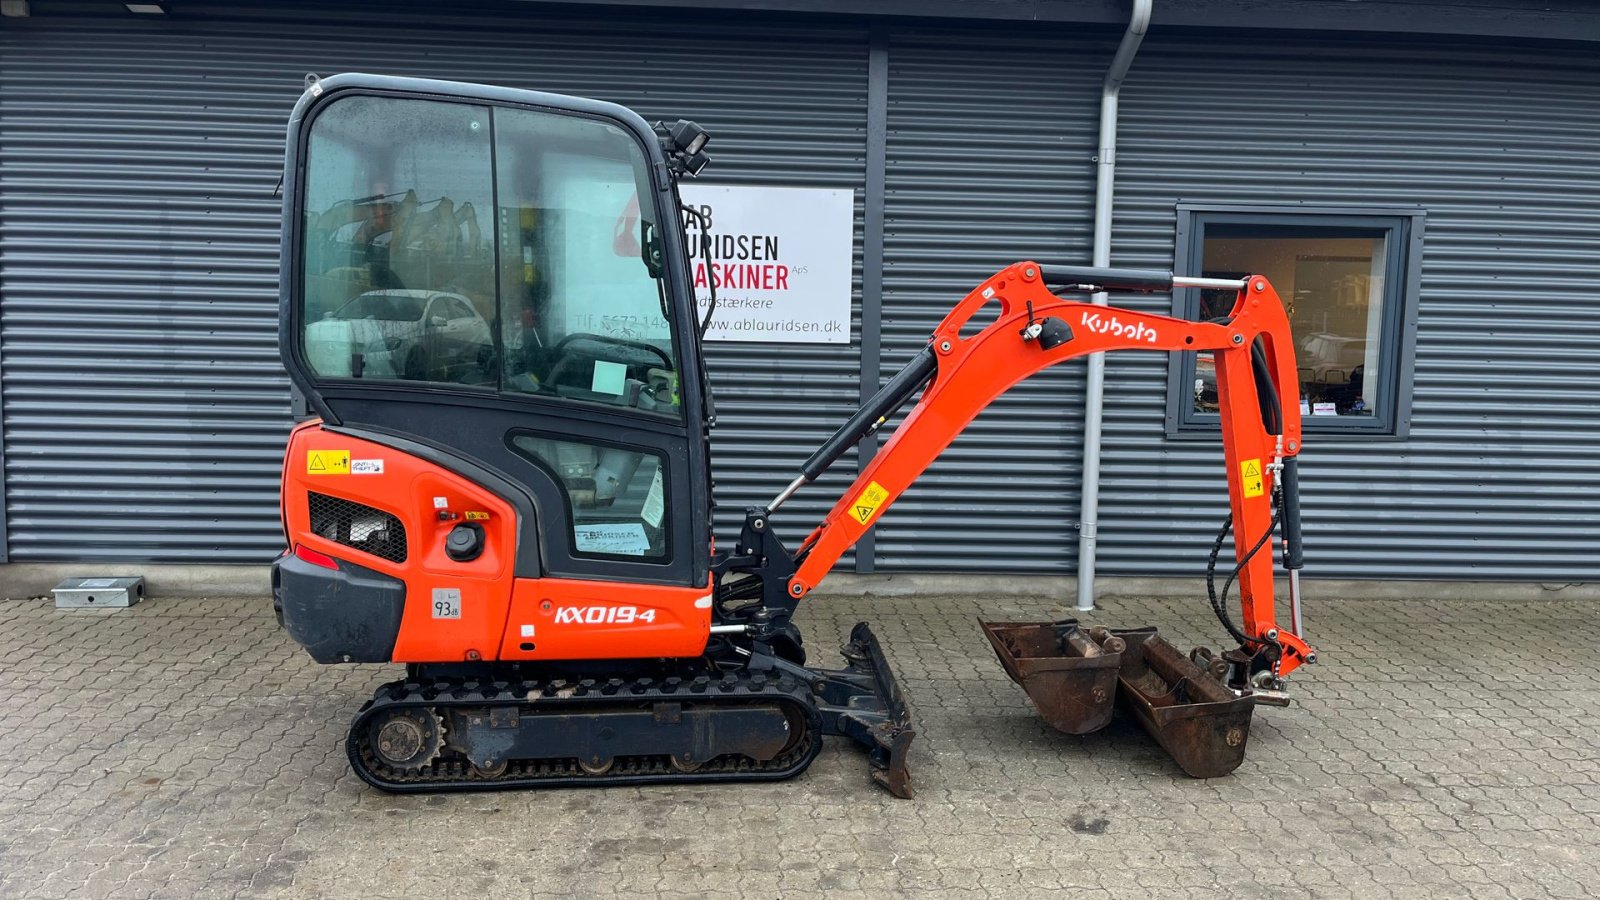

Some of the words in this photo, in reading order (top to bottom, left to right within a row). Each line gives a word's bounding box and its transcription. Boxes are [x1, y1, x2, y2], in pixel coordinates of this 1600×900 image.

[685, 205, 712, 230] AB
[686, 234, 778, 261] URIDSEN
[694, 263, 788, 290] ASKINER
[792, 265, 809, 275] ApS
[716, 296, 774, 309] stærkere
[1081, 311, 1157, 343] Kubota
[435, 601, 451, 616] 93
[554, 606, 656, 624] KX019-4
